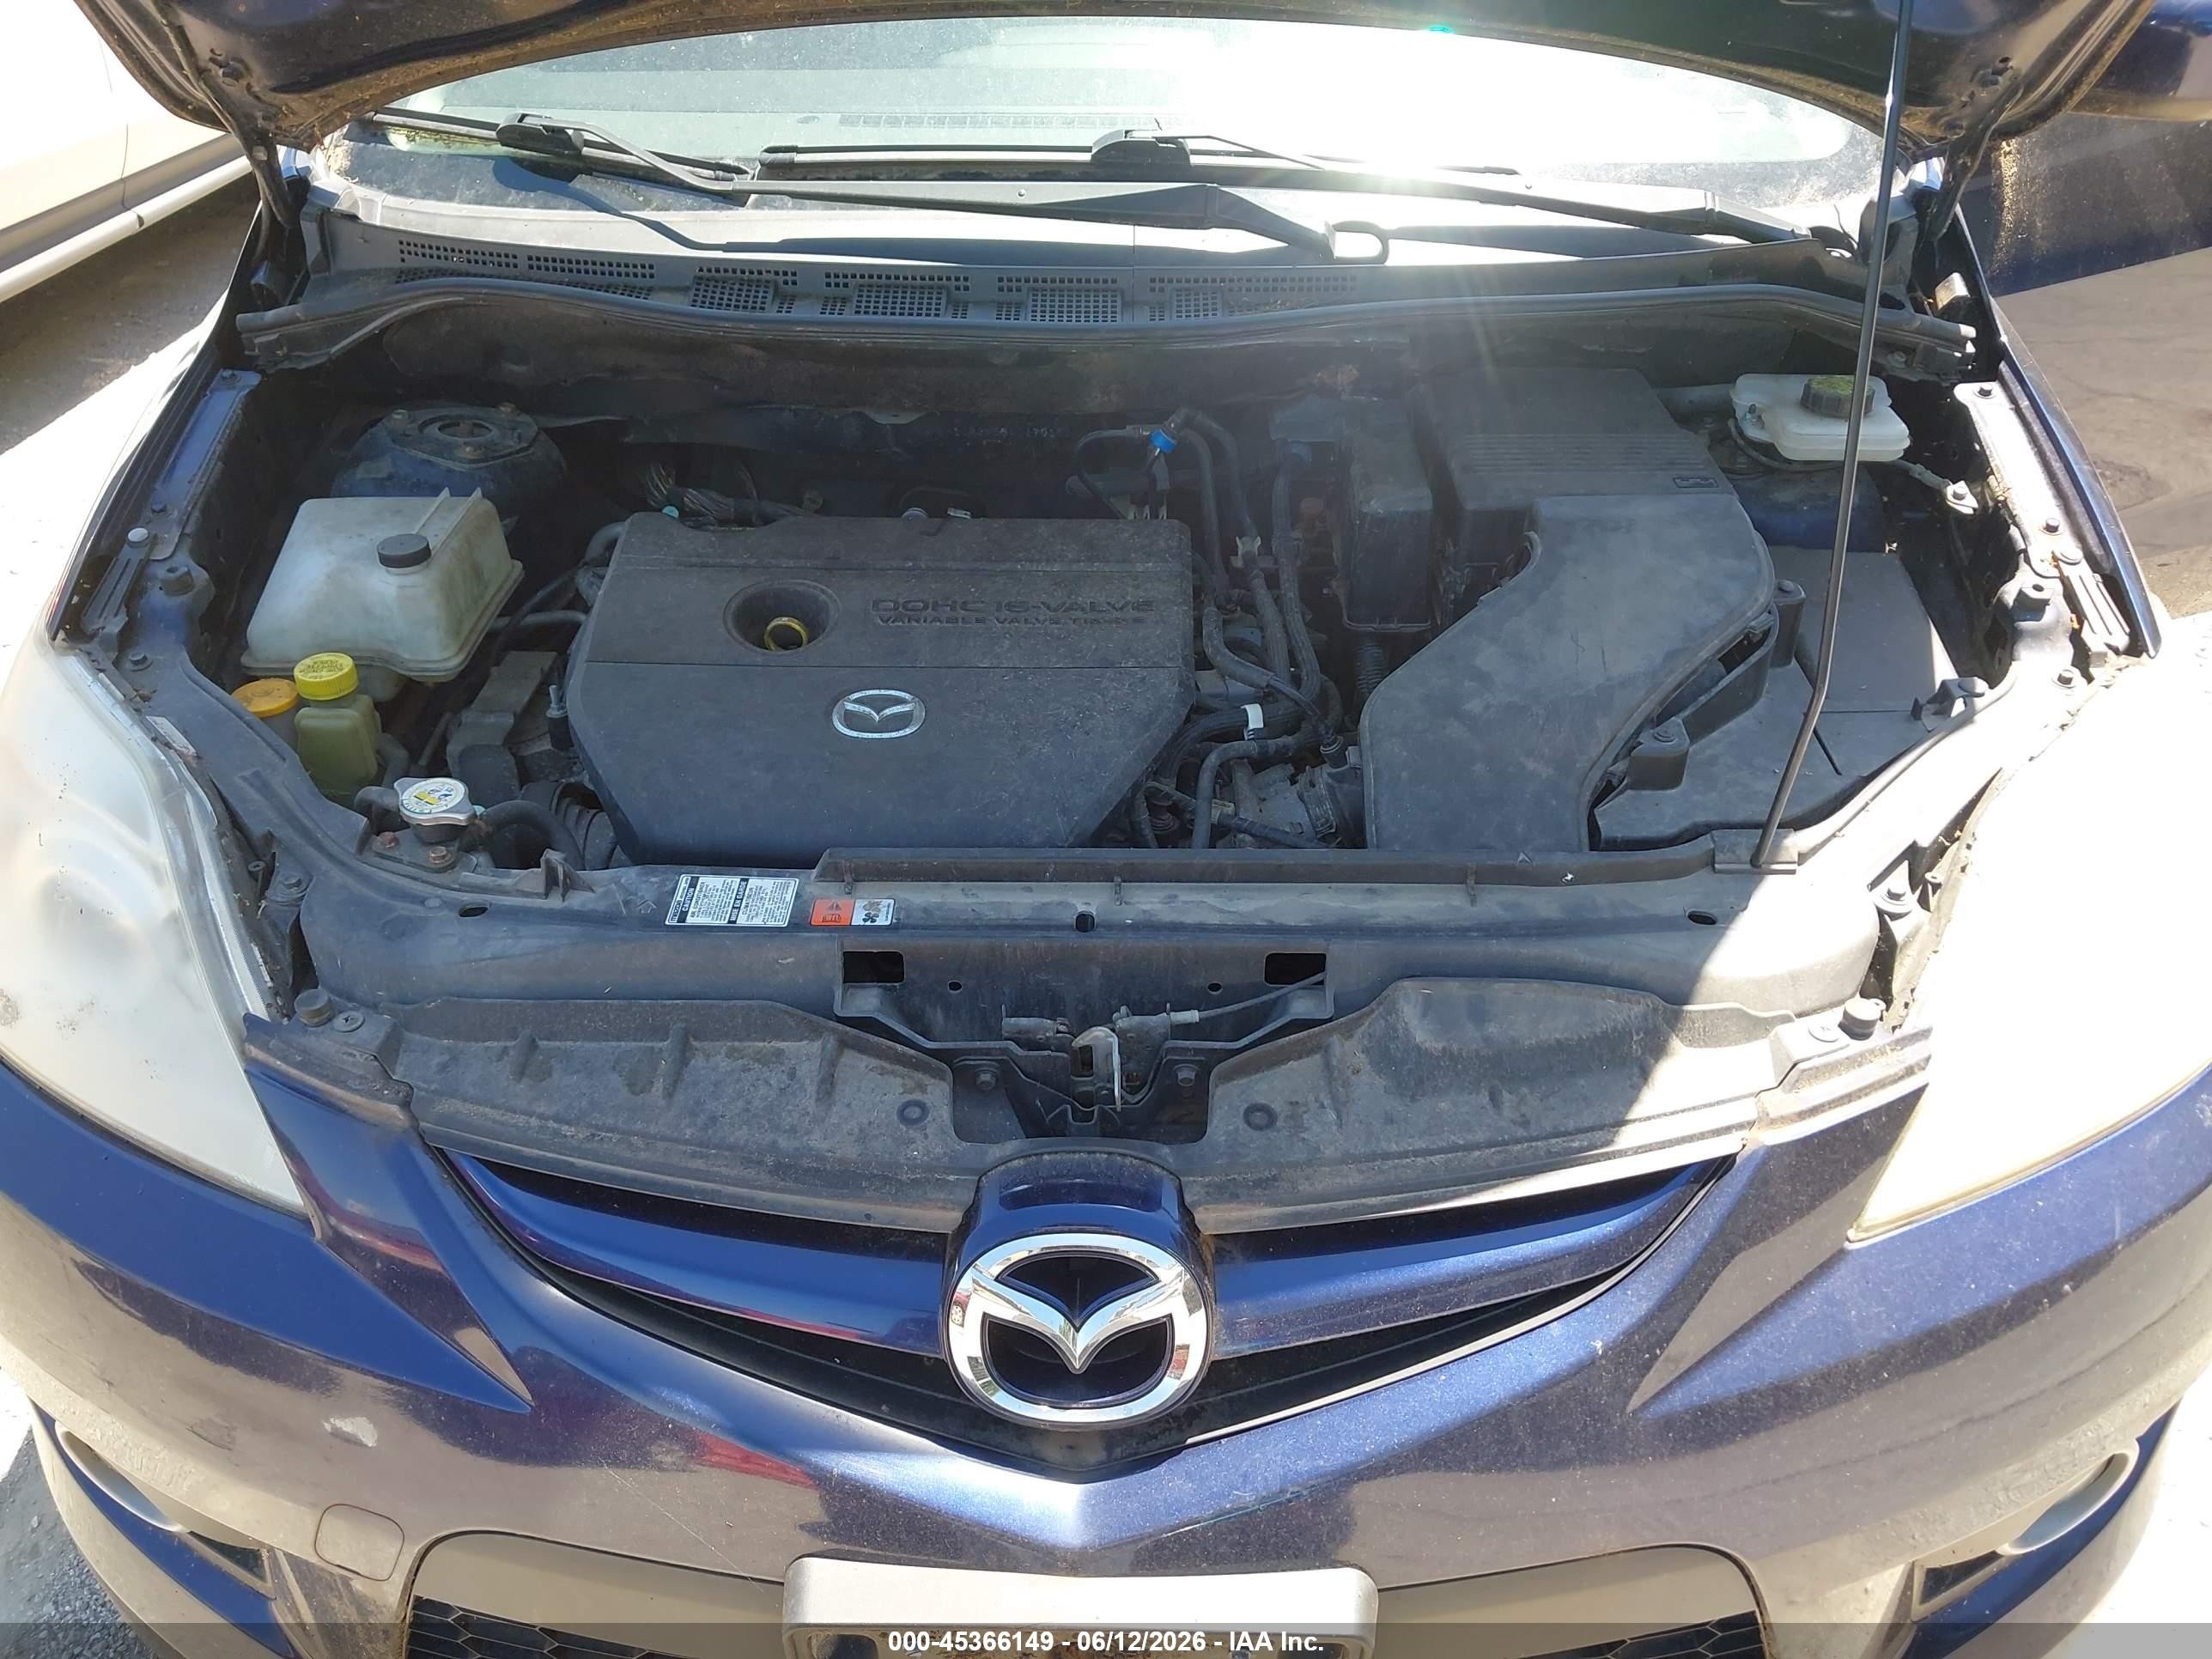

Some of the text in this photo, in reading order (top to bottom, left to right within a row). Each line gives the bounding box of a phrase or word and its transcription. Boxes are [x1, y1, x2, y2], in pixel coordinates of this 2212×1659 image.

[872, 599, 1155, 613] DOHC 16-VALVE
[878, 615, 984, 625] VARIABLE
[994, 616, 1063, 625] VALVE
[681, 887, 695, 911] CAUTION
[730, 908, 738, 921] MISE
